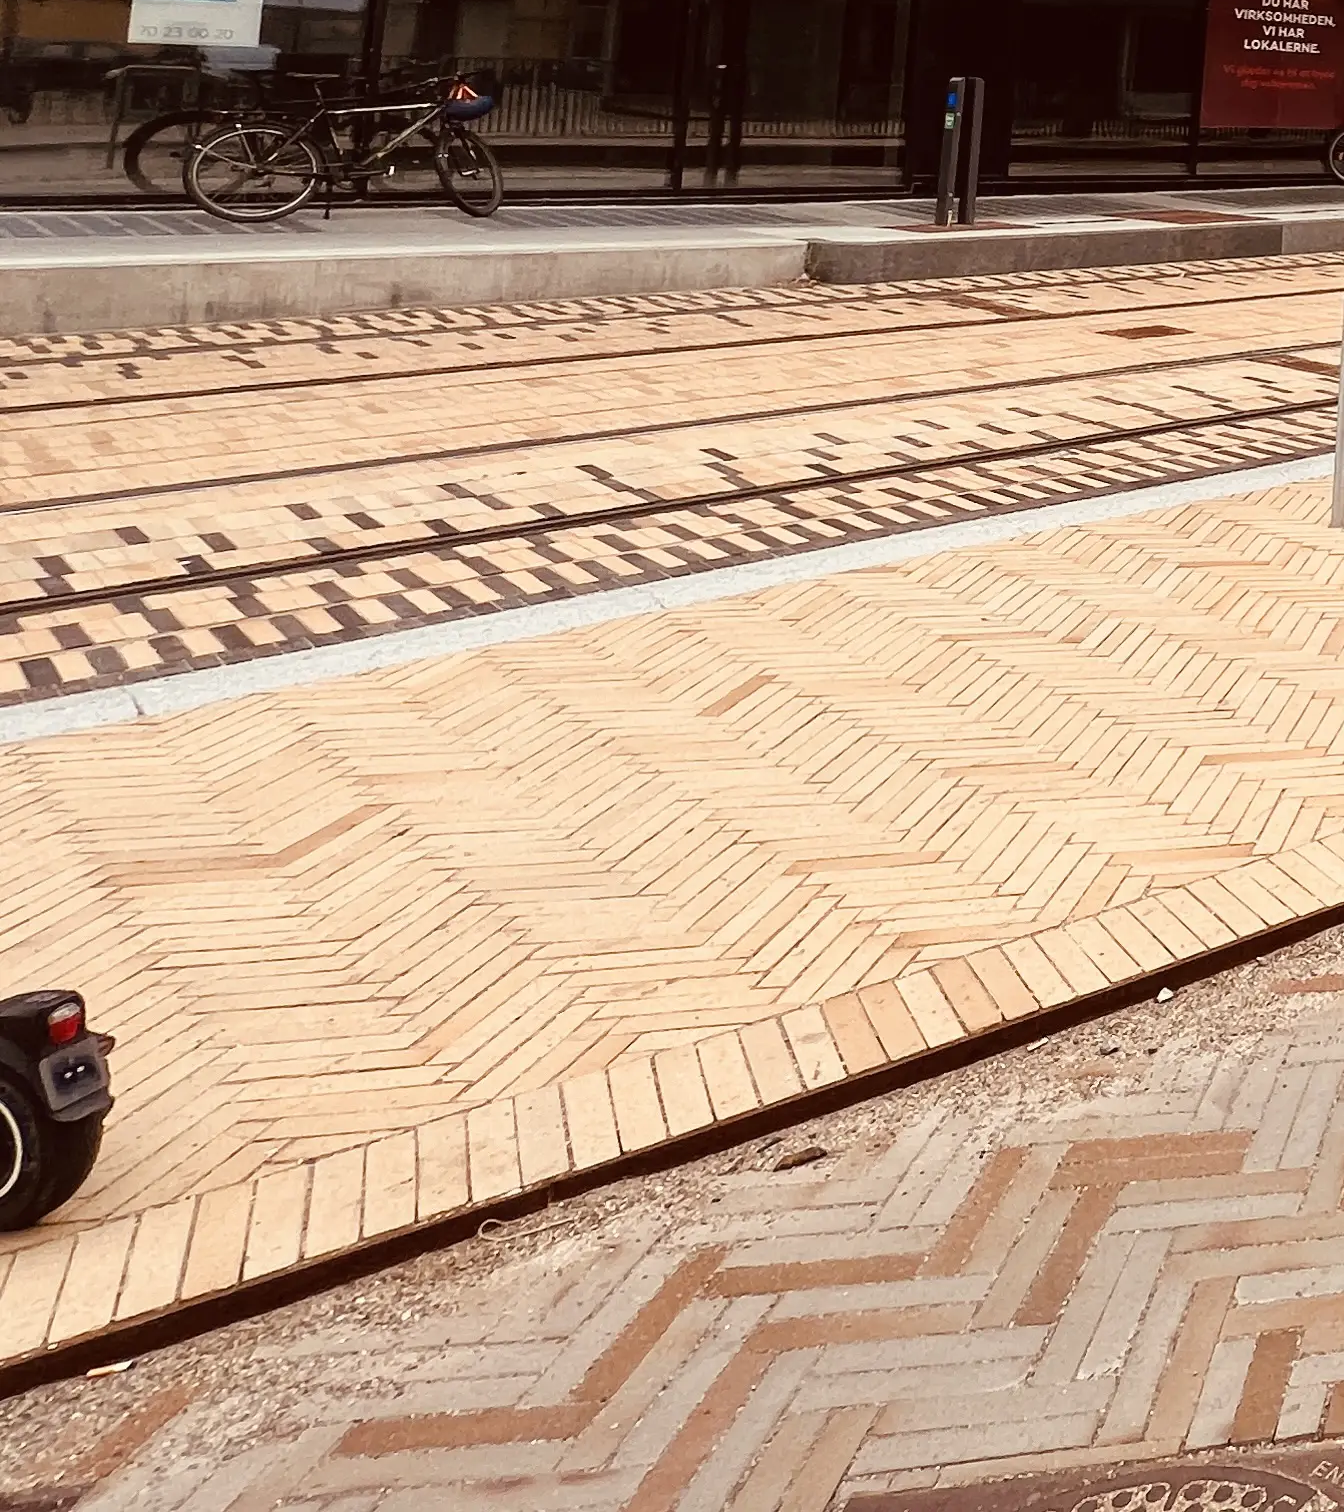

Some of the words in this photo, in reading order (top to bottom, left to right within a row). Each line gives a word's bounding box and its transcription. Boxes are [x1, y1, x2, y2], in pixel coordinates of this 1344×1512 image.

[1234, 8, 1336, 28] VIRKSOMHEDEN,
[1262, 25, 1276, 37] VI
[1278, 26, 1305, 39] HAR
[1244, 39, 1320, 54] LOKALERNE.
